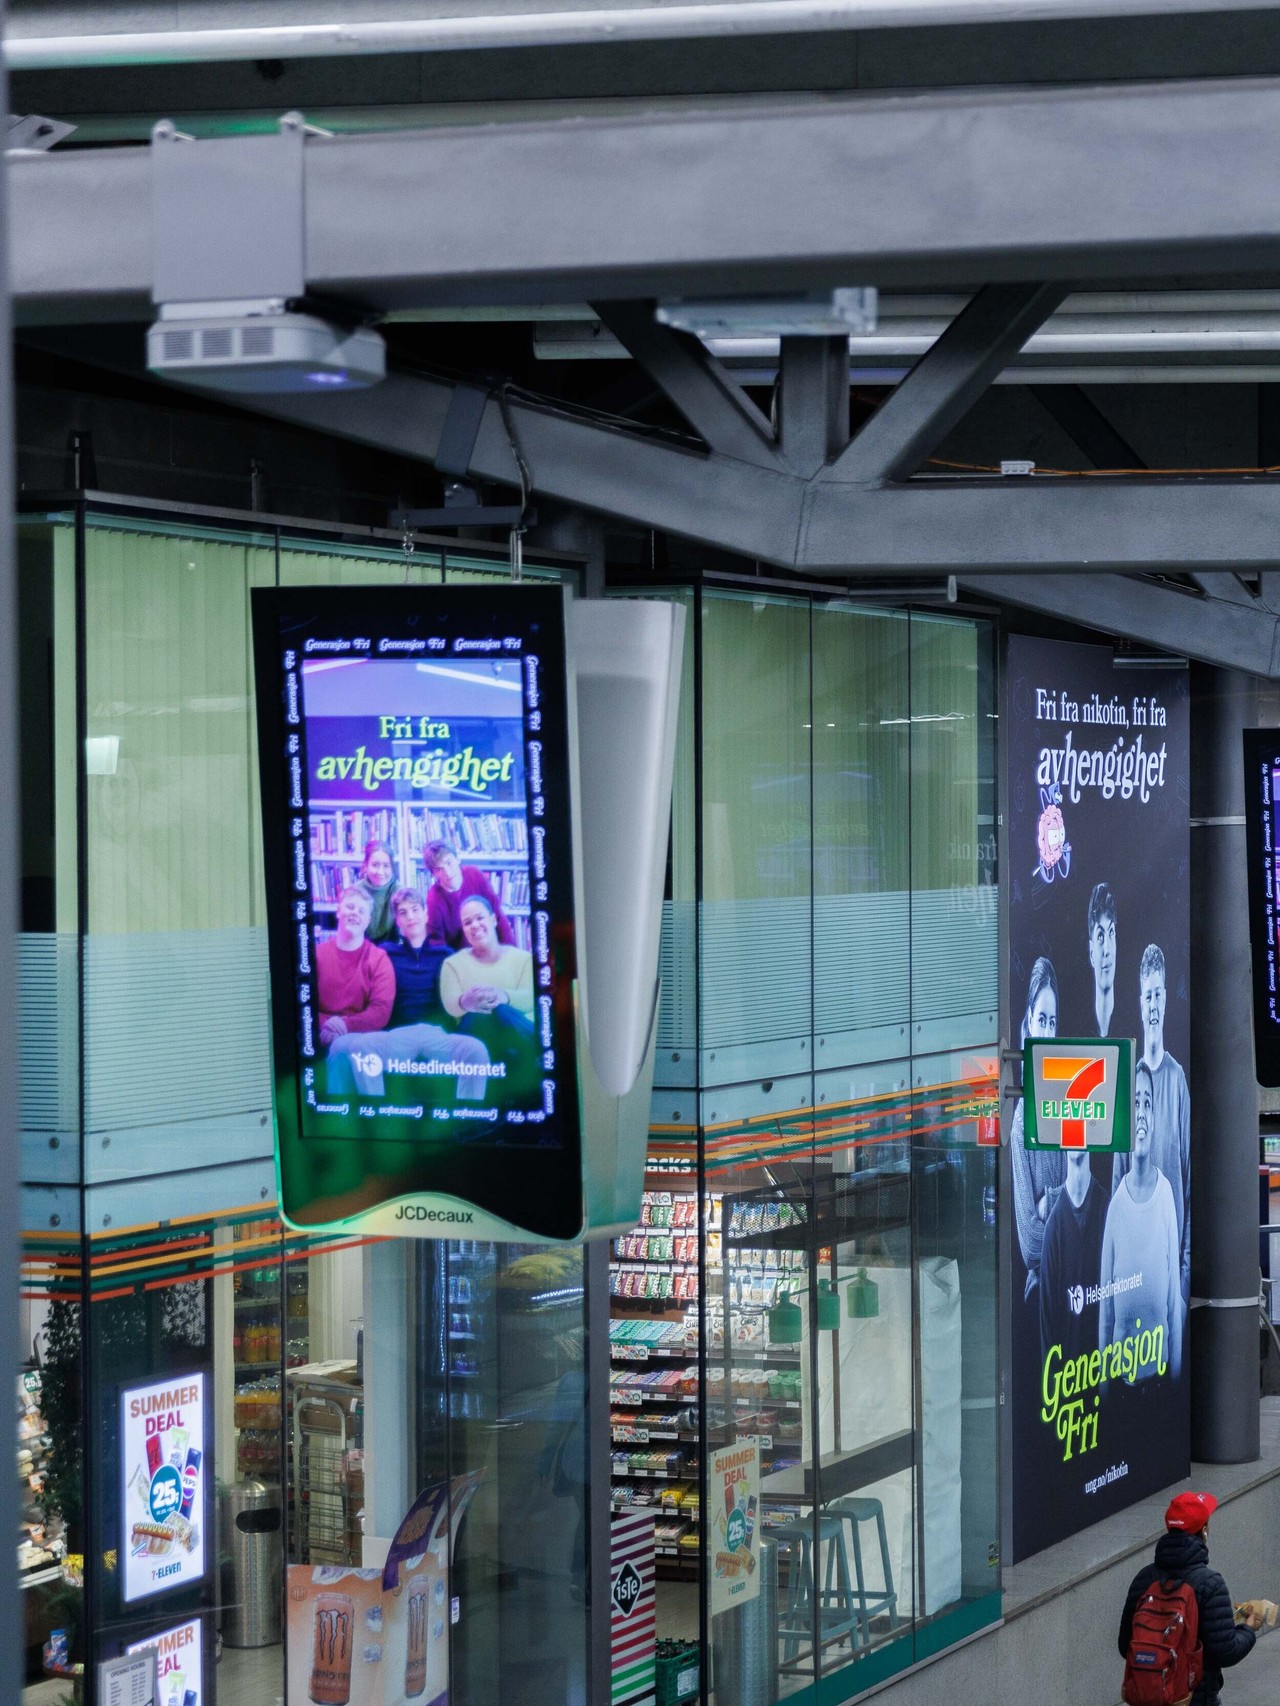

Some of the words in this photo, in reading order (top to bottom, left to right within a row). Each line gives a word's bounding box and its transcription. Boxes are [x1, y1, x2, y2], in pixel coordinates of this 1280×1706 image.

[305, 638, 351, 652] Generasjon
[353, 638, 371, 650] Fri
[380, 638, 425, 651] Generasjon
[428, 638, 446, 650] Fri
[454, 638, 501, 651] Generasjon
[503, 637, 522, 650] Fri
[285, 650, 295, 669] Fri
[525, 655, 539, 708] Generasjon
[287, 673, 300, 723] Generasjon
[1036, 688, 1056, 720] Fri
[1061, 691, 1079, 723] fra
[1083, 694, 1130, 729] nikotin,
[1133, 697, 1146, 725] fri
[1150, 698, 1167, 726] fra
[379, 716, 412, 738] Fri
[419, 716, 450, 738] fra
[530, 711, 541, 731] Fri
[288, 735, 299, 753] Fri
[316, 746, 514, 792] avhengighet
[528, 740, 543, 793] Generasjon
[1037, 730, 1167, 804] avhengighet
[291, 757, 303, 807] Generasjon
[533, 796, 544, 816] Fri
[293, 819, 302, 836] Fri
[532, 826, 546, 878] Generasjon
[295, 841, 307, 890] Generasjon
[537, 881, 548, 900] Fri
[296, 901, 306, 919] Fri
[300, 924, 310, 973] Generasjon
[536, 911, 550, 963] Generasjon
[540, 966, 551, 986] Fri
[301, 984, 310, 1002] Fri
[303, 1006, 315, 1056] Generasjon
[539, 996, 552, 1047] Generasjon
[387, 1058, 506, 1077] Helsedirektoratet
[543, 1050, 554, 1069] Fri
[305, 1068, 314, 1085] Fri
[395, 1205, 474, 1224] JCDecaux
[1086, 1271, 1143, 1305] Helsedirektoratet
[1041, 1318, 1167, 1423] Generasjon
[130, 1385, 198, 1418] SUMMER
[145, 1410, 185, 1436] DEAL
[1057, 1396, 1099, 1462] Fri
[715, 1447, 756, 1473] SUMMER
[724, 1467, 747, 1487] DEAL
[1085, 1461, 1128, 1494] ung.no/nikotin
[158, 1654, 181, 1679] EAL
